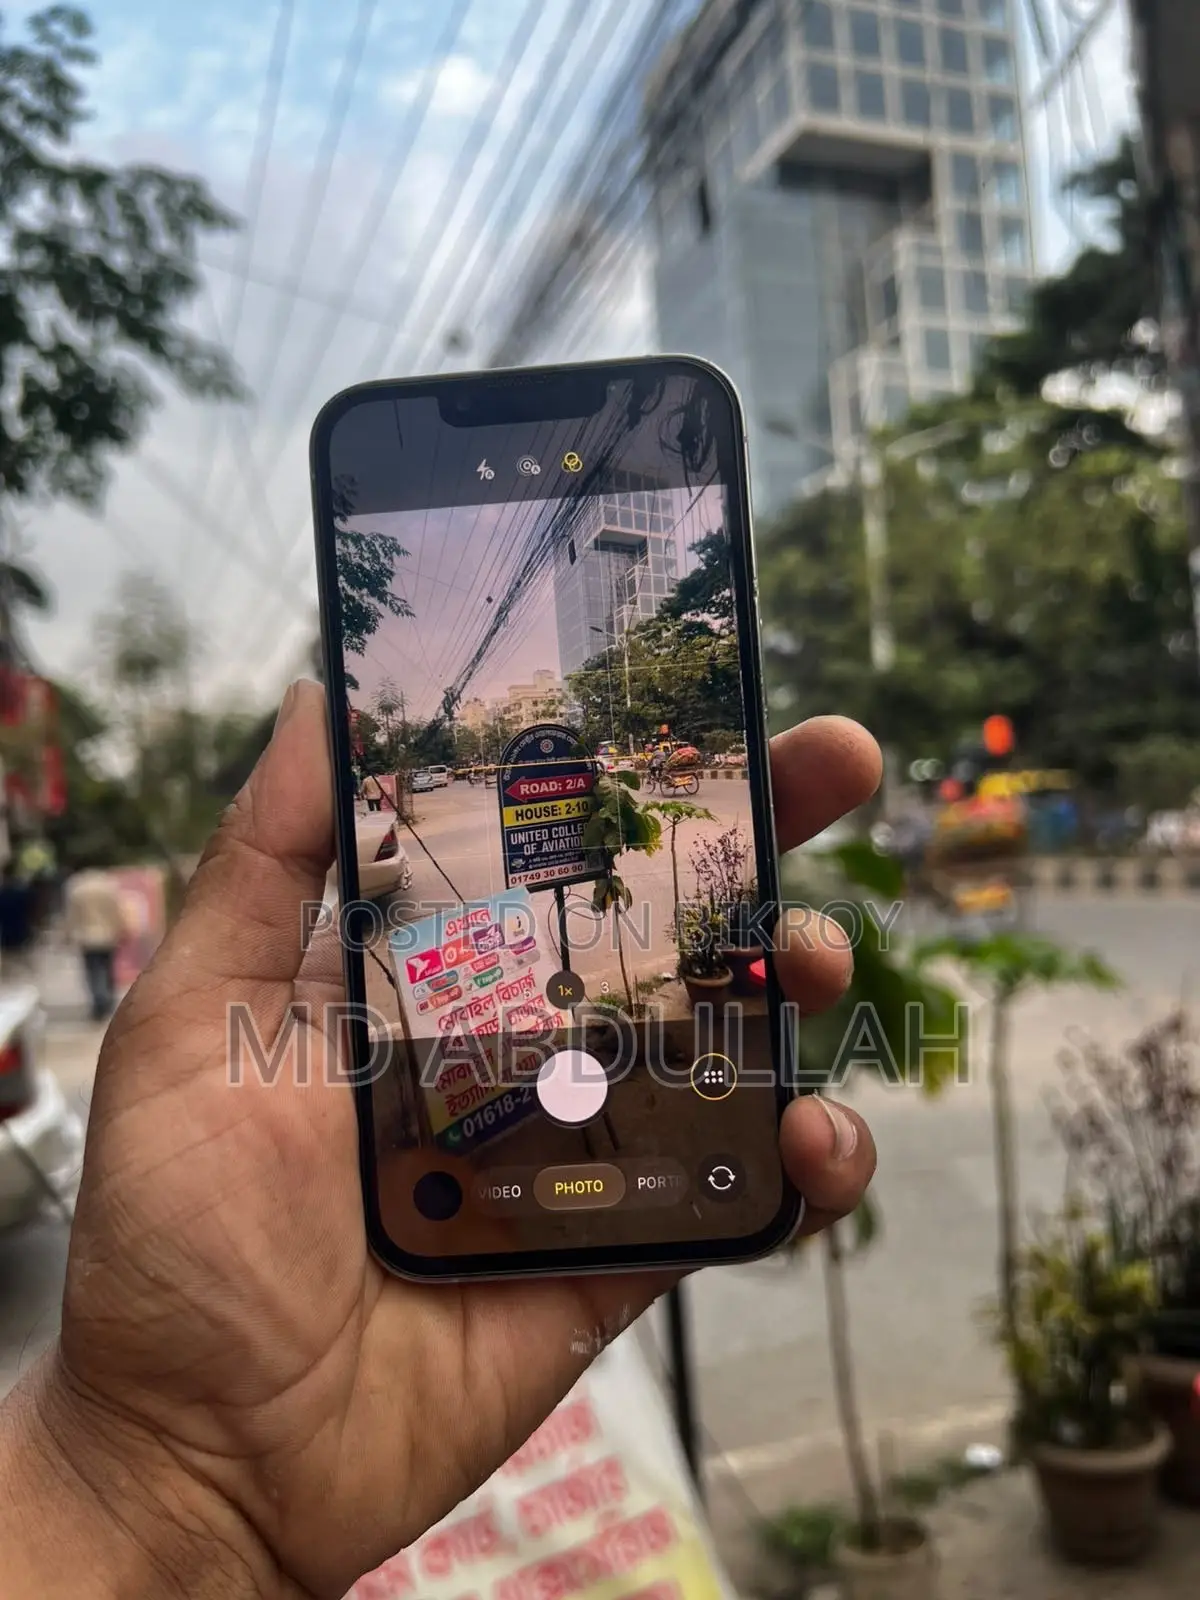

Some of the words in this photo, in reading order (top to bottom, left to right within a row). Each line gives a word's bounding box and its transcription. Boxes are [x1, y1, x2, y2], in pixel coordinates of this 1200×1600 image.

[519, 780, 563, 796] ROAD:
[565, 778, 586, 791] 2/A
[515, 805, 562, 822] HOUSE:
[510, 828, 549, 845] UNITED
[523, 843, 537, 856] OF
[510, 872, 541, 885] 01749
[543, 869, 555, 878] 30
[557, 984, 573, 997] 1x
[600, 981, 610, 994] 3
[478, 1185, 522, 1199] VIDEO
[554, 1179, 604, 1195] PHOTO
